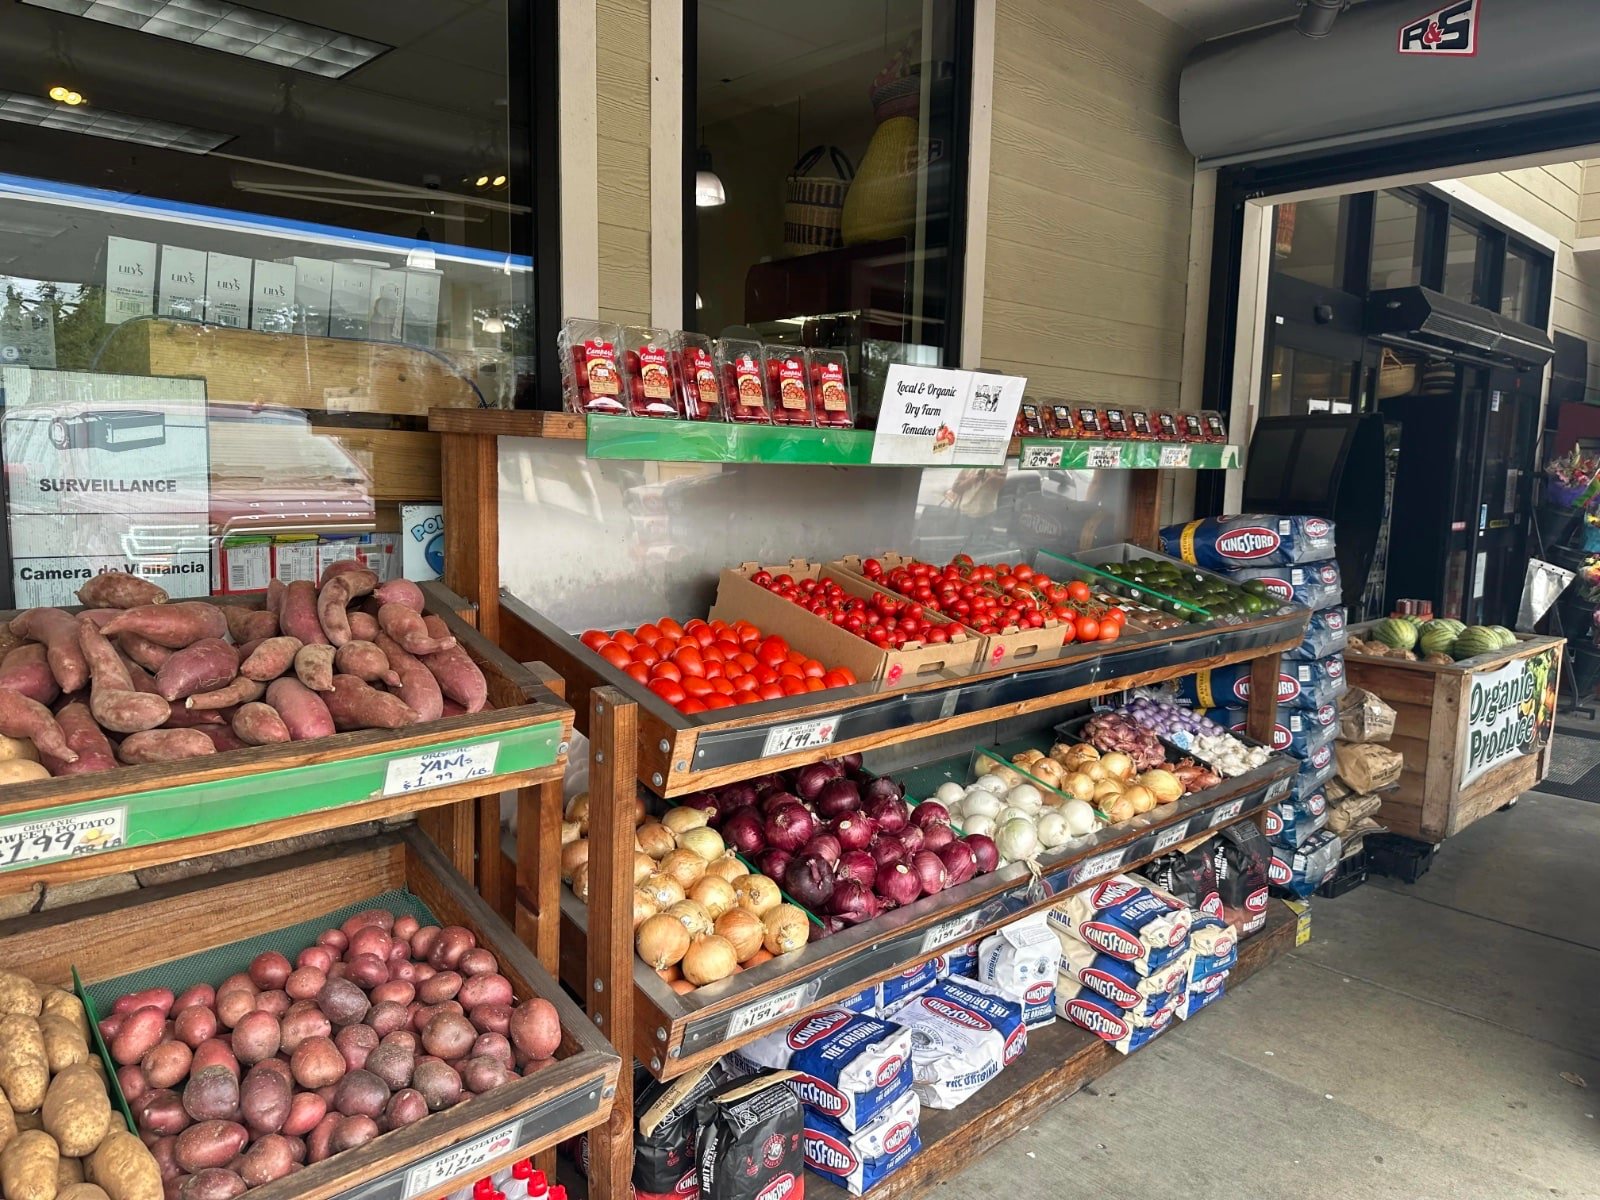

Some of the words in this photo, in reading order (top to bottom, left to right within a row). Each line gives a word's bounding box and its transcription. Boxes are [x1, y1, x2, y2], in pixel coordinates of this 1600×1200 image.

[586, 347, 613, 357] Campari
[640, 353, 665, 362] Campari
[897, 381, 917, 396] Local
[918, 382, 925, 395] &
[927, 383, 957, 399] Organic
[905, 402, 920, 418] Dry
[921, 403, 941, 416] Farm
[901, 423, 935, 436] Tomatoes
[39, 478, 177, 492] SURVEILLANCE
[1221, 533, 1274, 554] KINGSFORD
[20, 567, 92, 581] Camera
[1470, 668, 1536, 727] Organic
[1469, 713, 1536, 772] Produce
[403, 771, 453, 790] $1.99
[23, 817, 76, 832] ORGANIC
[56, 817, 116, 834] POTATO
[1121, 908, 1138, 920] THE
[1084, 925, 1139, 956] KINGSFORD
[943, 984, 990, 1009] ORIGINAL
[928, 999, 987, 1029] KINGSFORD
[989, 1002, 1011, 1018] THE
[1070, 1004, 1123, 1036] KINGSFORD
[793, 1011, 848, 1045] KINGSFORD
[820, 1043, 845, 1060] THE
[838, 1021, 885, 1047] ORIGINAL
[964, 1061, 998, 1086] ORIGINAL
[436, 1153, 459, 1167] RED
[464, 1129, 513, 1154] POTATOES
[804, 1138, 851, 1169] NGSFORD
